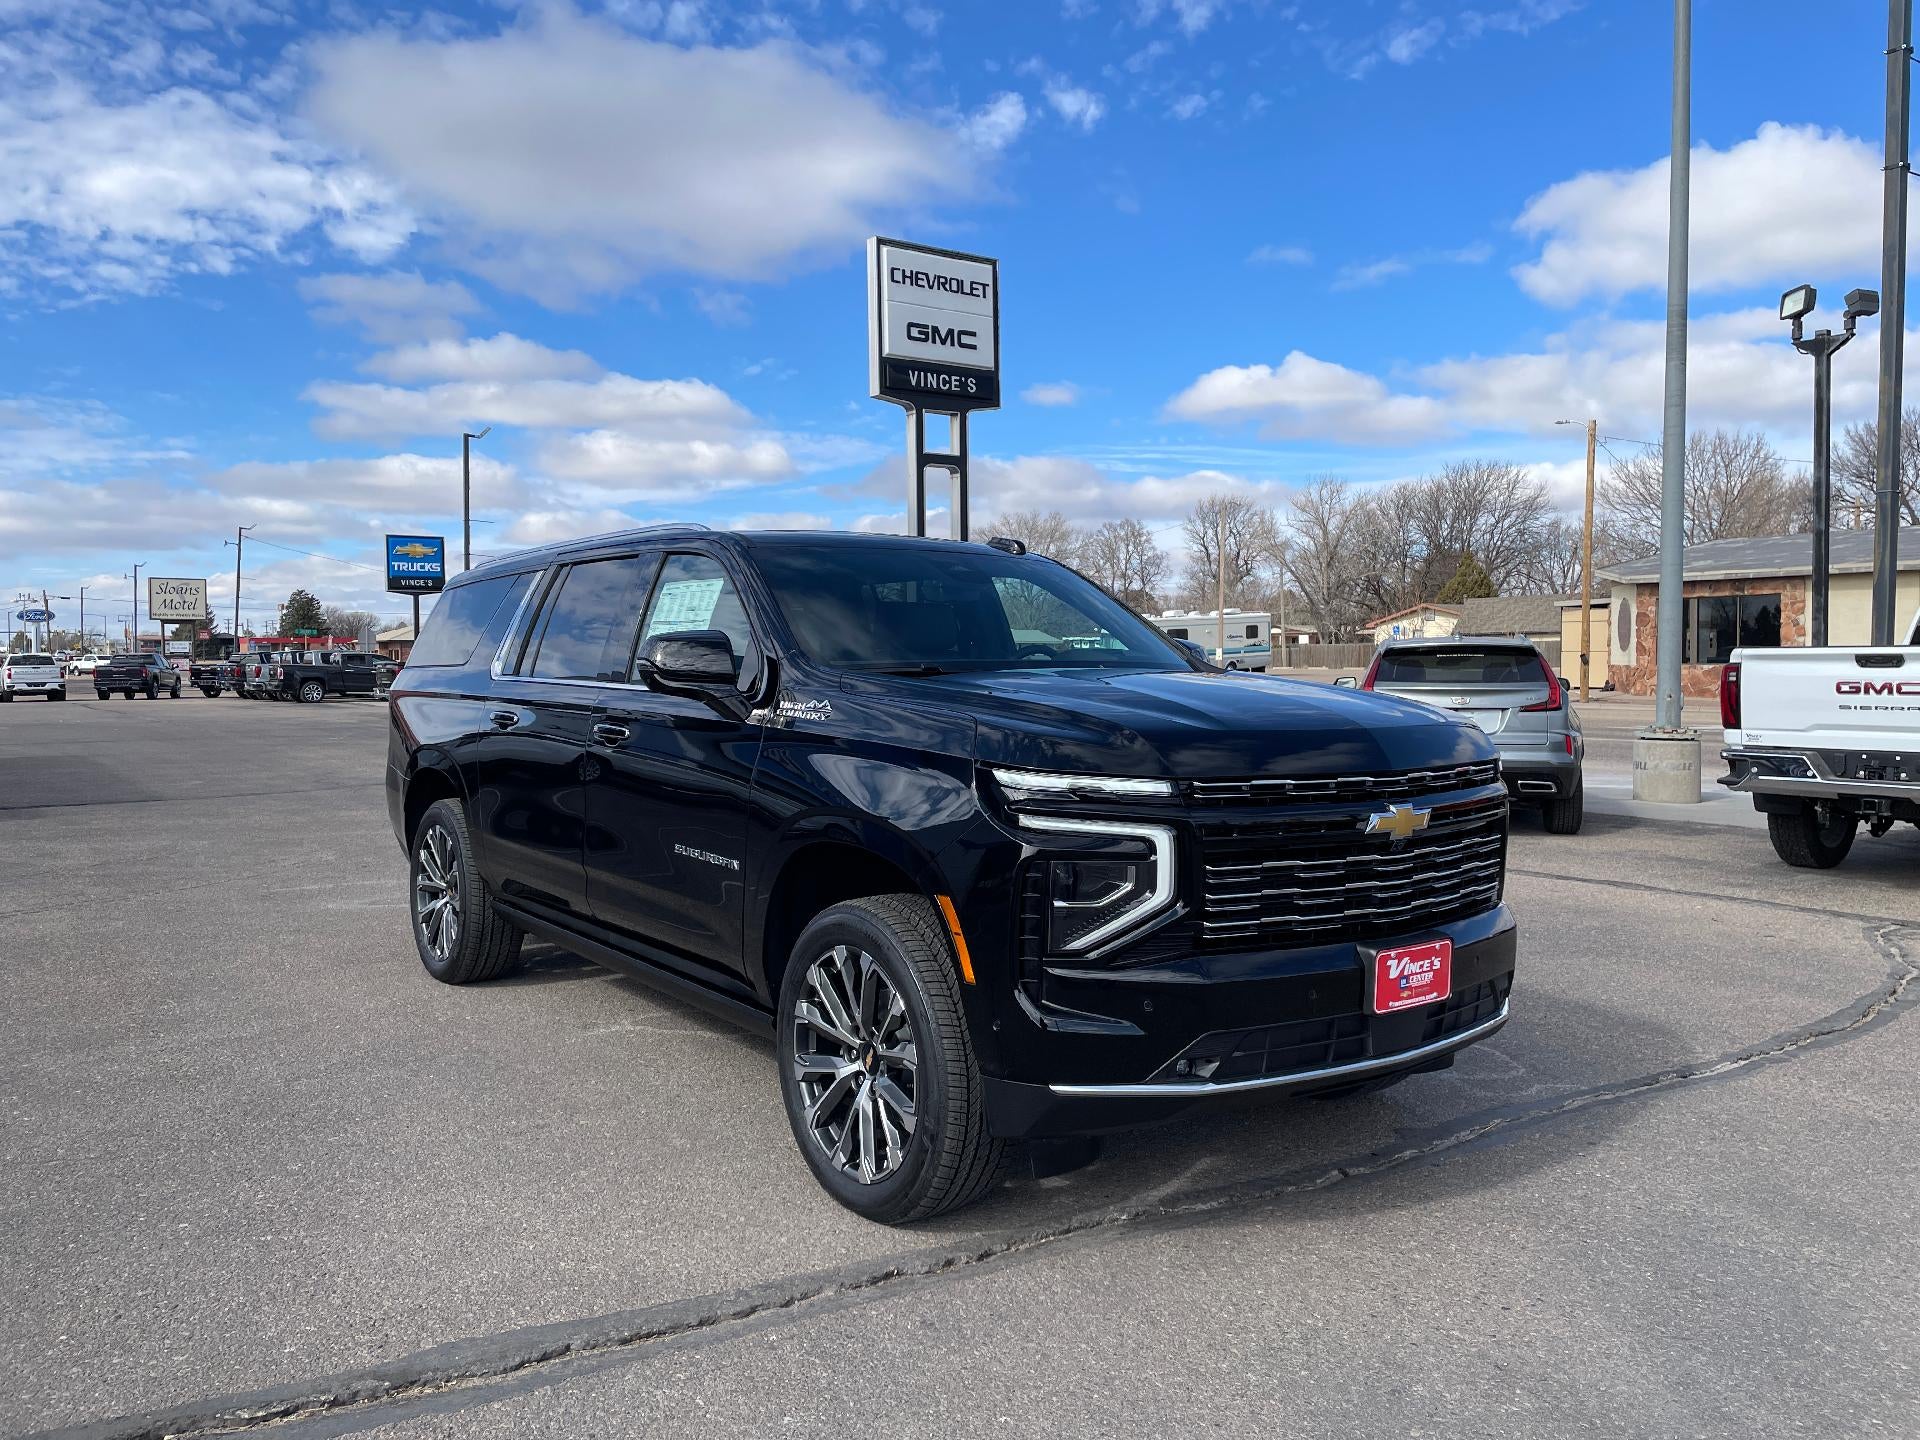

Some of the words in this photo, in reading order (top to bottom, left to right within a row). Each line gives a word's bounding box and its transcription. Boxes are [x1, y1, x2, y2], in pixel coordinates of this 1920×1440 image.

[890, 267, 990, 299] CHEVROLET
[906, 321, 978, 351] GMC
[908, 369, 977, 393] VINCE'S
[391, 561, 441, 572] TRUCKS
[155, 581, 200, 596] Sloans
[401, 579, 433, 587] VINCE'S
[157, 597, 198, 611] Motel
[1836, 681, 1920, 696] GMC
[780, 700, 806, 711] HIGH
[777, 708, 831, 721] COUNTRY
[674, 843, 740, 871] SUBURBAN
[1386, 956, 1442, 980] VINCE'S
[1410, 971, 1434, 983] CENTER
